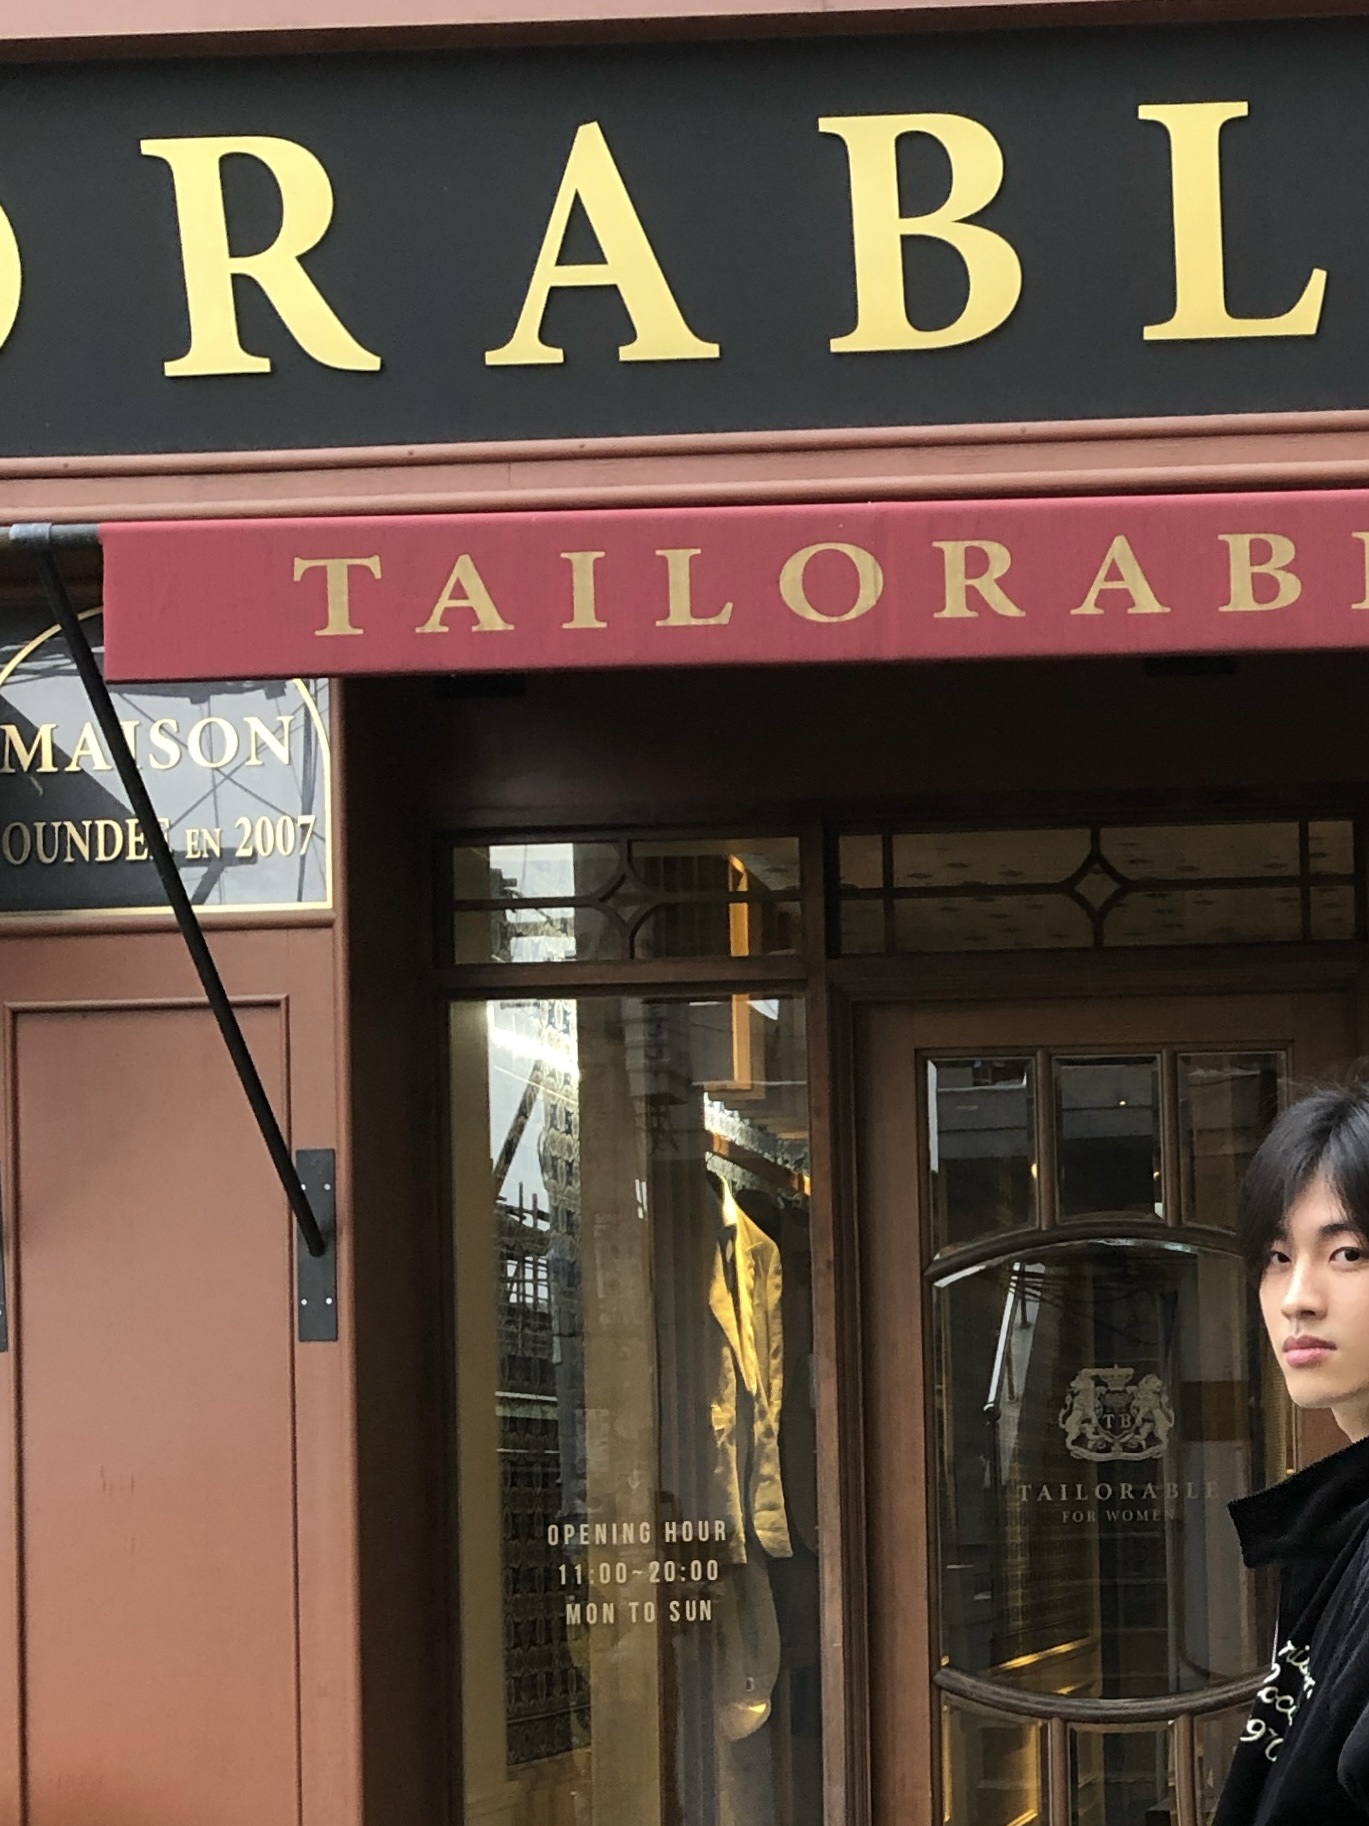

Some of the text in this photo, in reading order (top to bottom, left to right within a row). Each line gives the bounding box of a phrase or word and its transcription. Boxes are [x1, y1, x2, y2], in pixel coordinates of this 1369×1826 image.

[185, 827, 222, 860] EN
[235, 815, 316, 858] 2007
[1017, 1481, 1220, 1502] TAILORABLE
[1062, 1508, 1176, 1523] FOR WOMEN
[547, 1520, 727, 1546] OPENING HOUR
[565, 1600, 712, 1626] MON TO SUN
